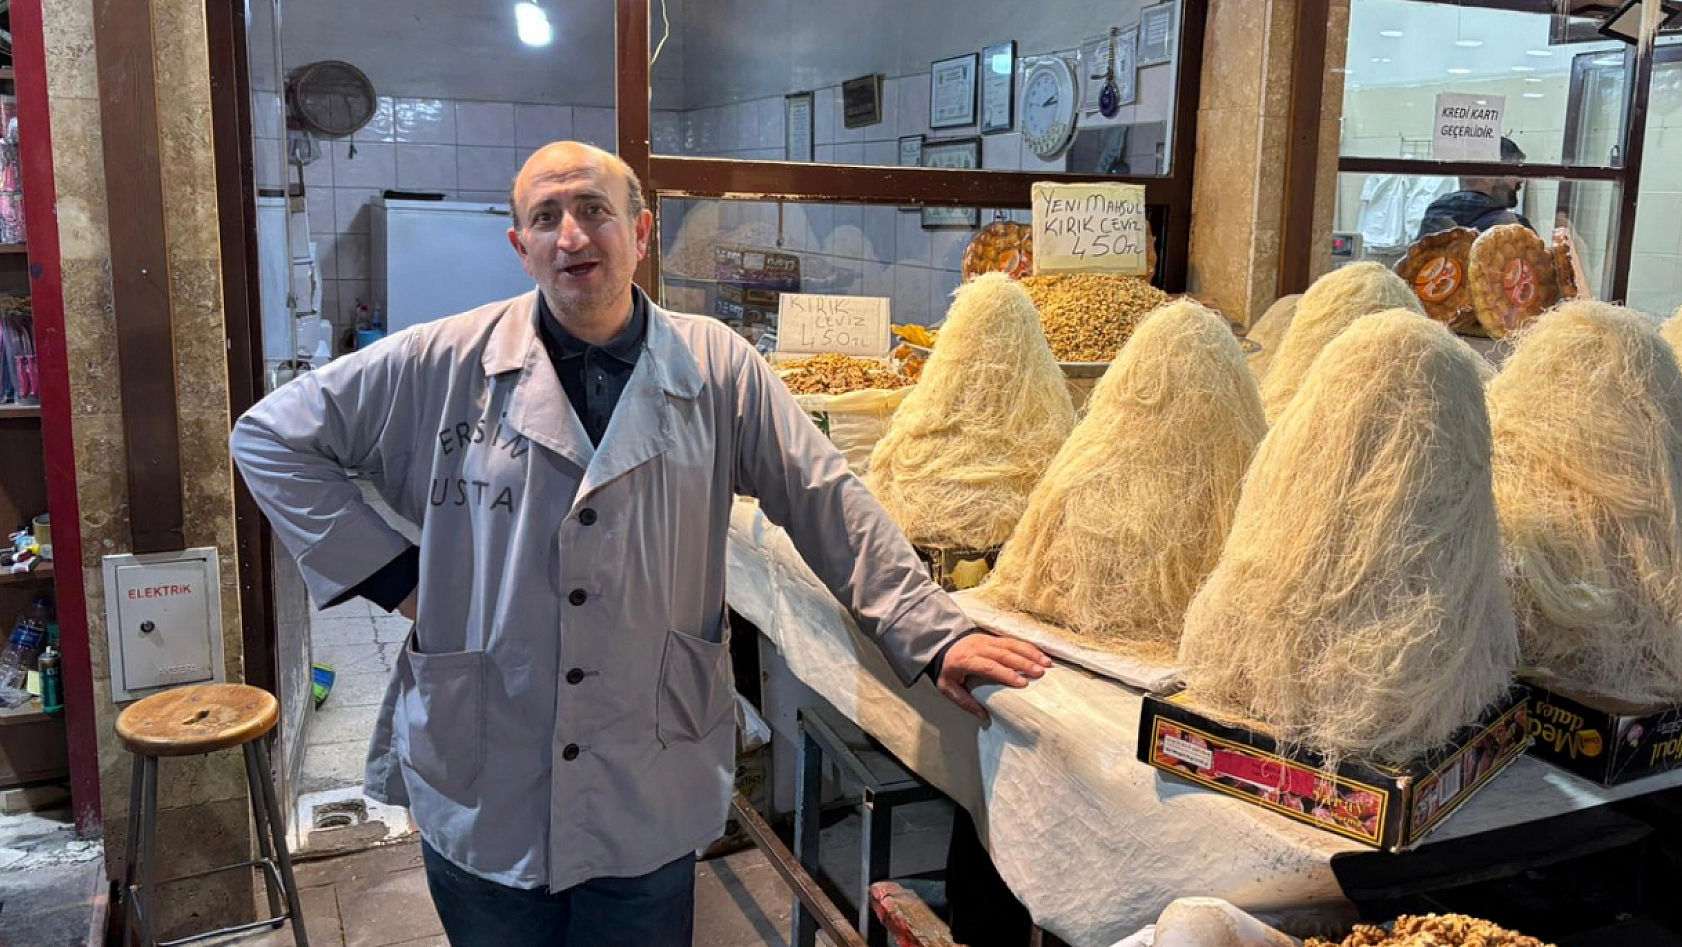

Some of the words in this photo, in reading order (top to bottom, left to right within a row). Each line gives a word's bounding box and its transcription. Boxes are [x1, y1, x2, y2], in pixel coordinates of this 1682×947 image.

[1441, 105, 1471, 119] KREDİ
[1471, 107, 1499, 121] KARTI
[1044, 215, 1095, 237] KIRIK
[790, 296, 851, 315] KIRIK
[430, 478, 514, 513] USTA
